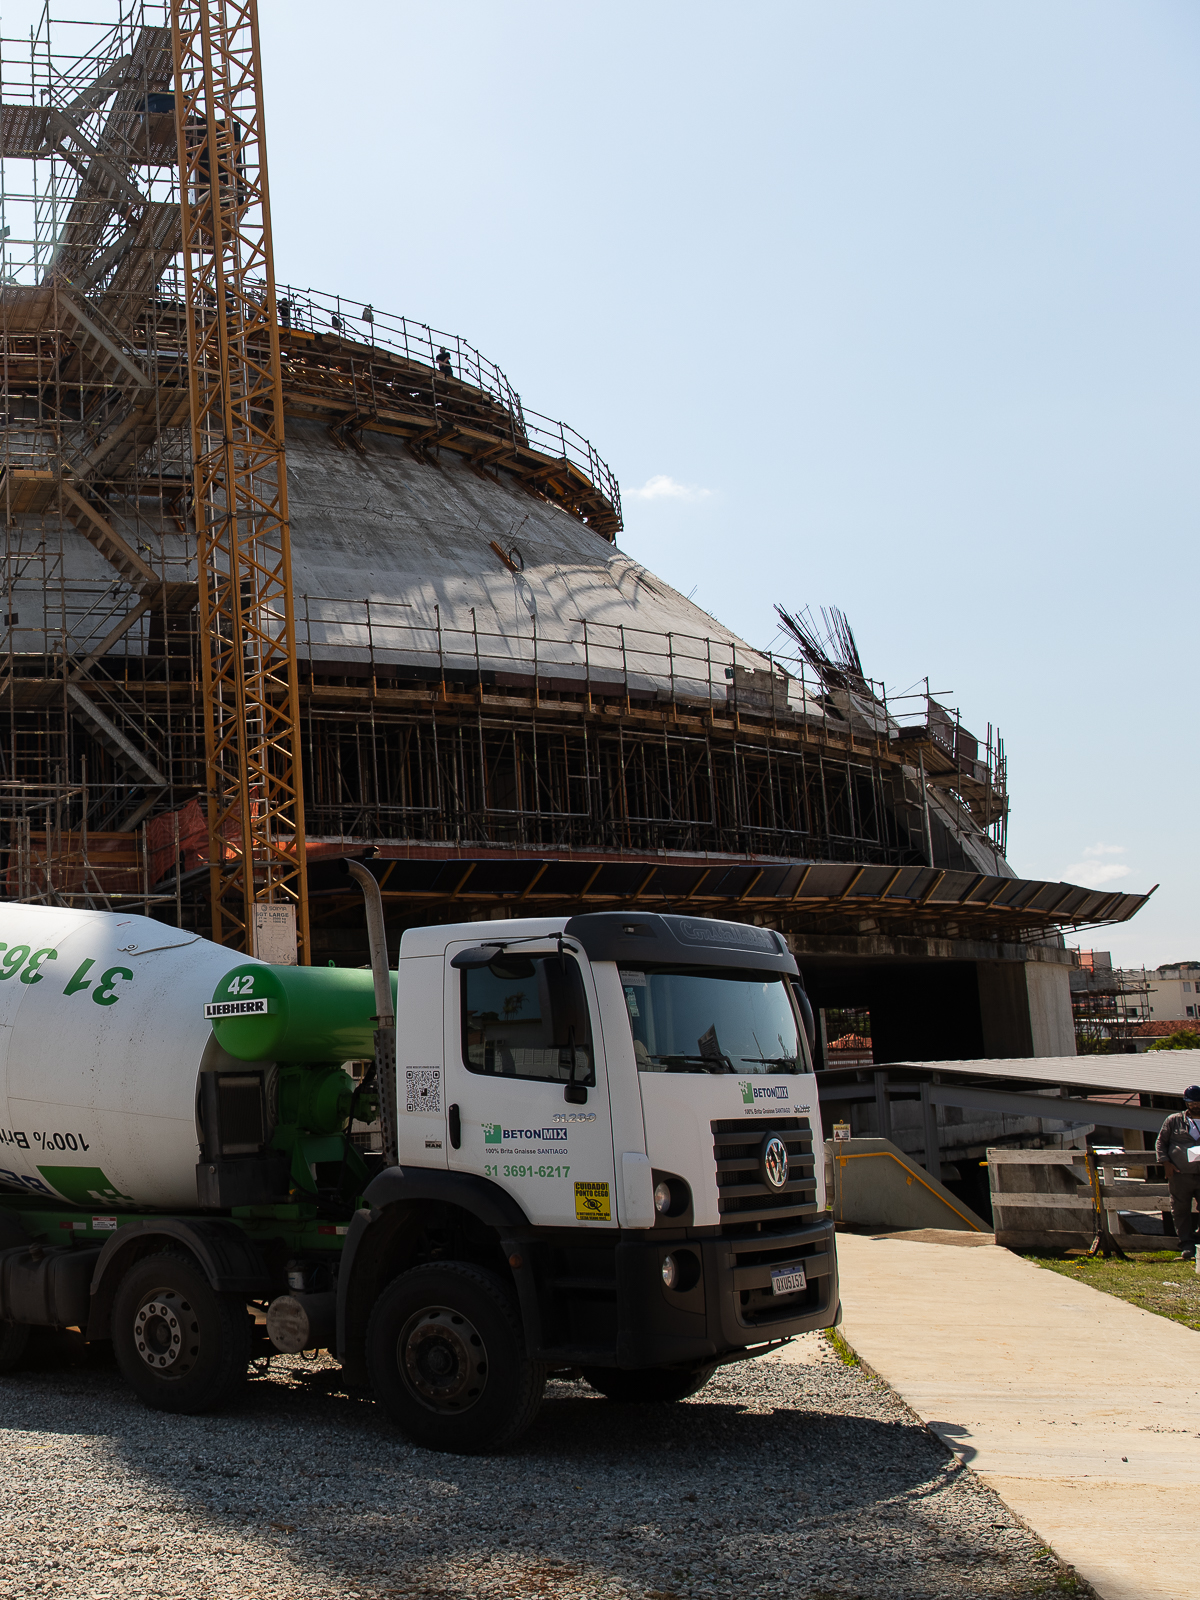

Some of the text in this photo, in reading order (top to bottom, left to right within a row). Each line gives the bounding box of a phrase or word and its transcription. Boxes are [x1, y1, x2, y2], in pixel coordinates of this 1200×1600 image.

[62, 957, 134, 1006] 31
[227, 975, 255, 995] 42
[206, 1001, 264, 1016] LIEBHERR
[753, 1086, 789, 1099] BETONMIX
[552, 1112, 597, 1123] 31.280
[503, 1128, 568, 1140] BETONMIX
[33, 1131, 90, 1152] 100%
[484, 1165, 571, 1178] 31 3691-6217
